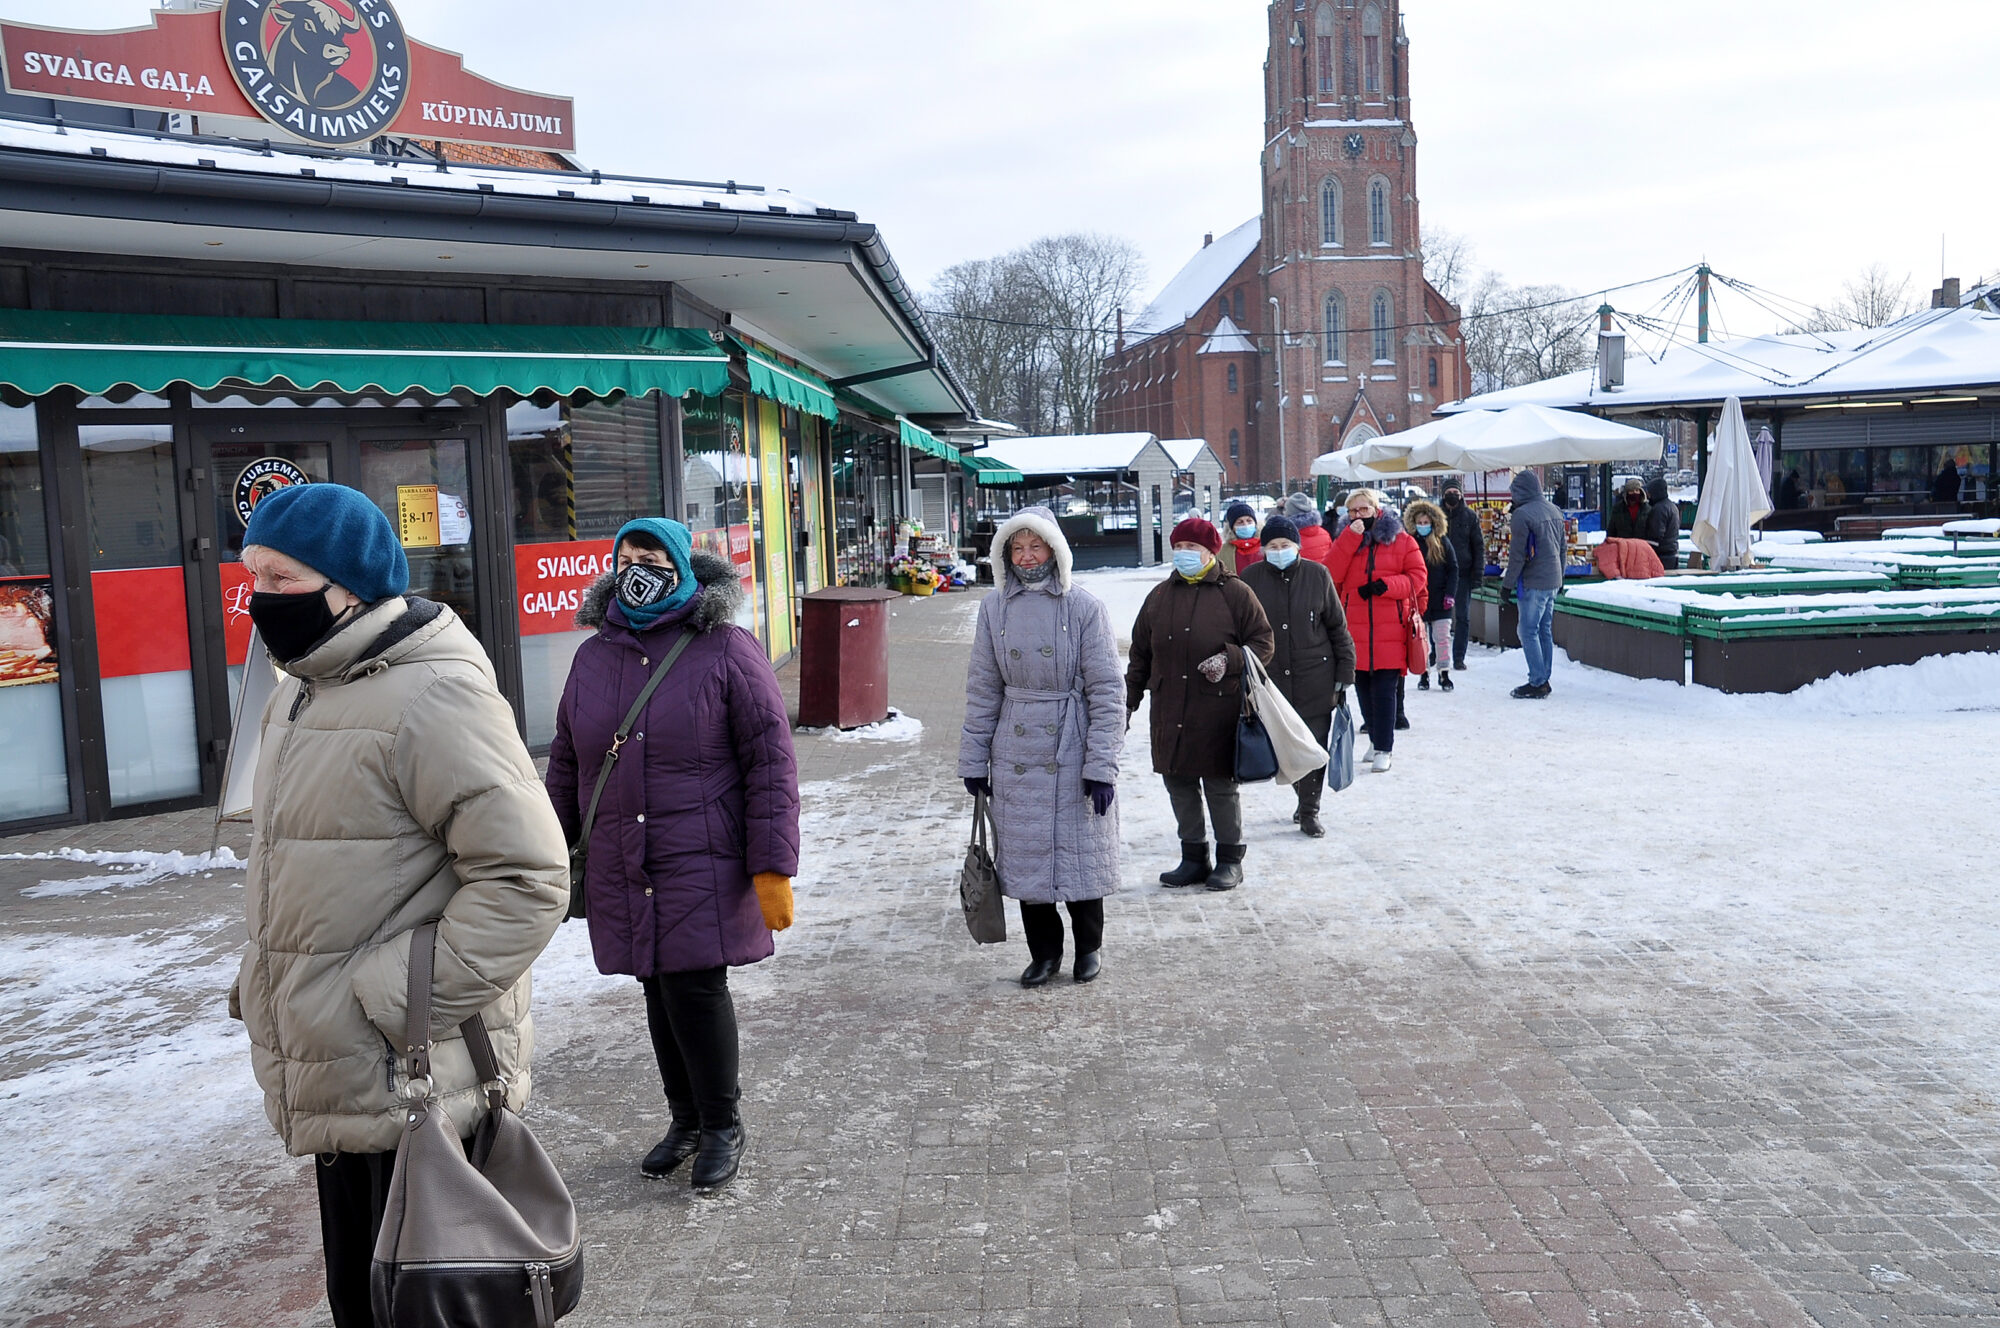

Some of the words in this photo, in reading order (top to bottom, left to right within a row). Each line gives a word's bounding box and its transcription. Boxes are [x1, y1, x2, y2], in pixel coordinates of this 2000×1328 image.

[24, 52, 135, 87] SVAIGA
[141, 68, 215, 102] GAĻA
[235, 41, 401, 137] GAĻSAIMNIEKS
[421, 100, 562, 135] KŪPINĀJUMI
[241, 462, 304, 487] KURZEMES
[409, 512, 433, 523] 8-17
[537, 554, 600, 579] SVAIGA
[523, 589, 579, 619] GAĻAS
